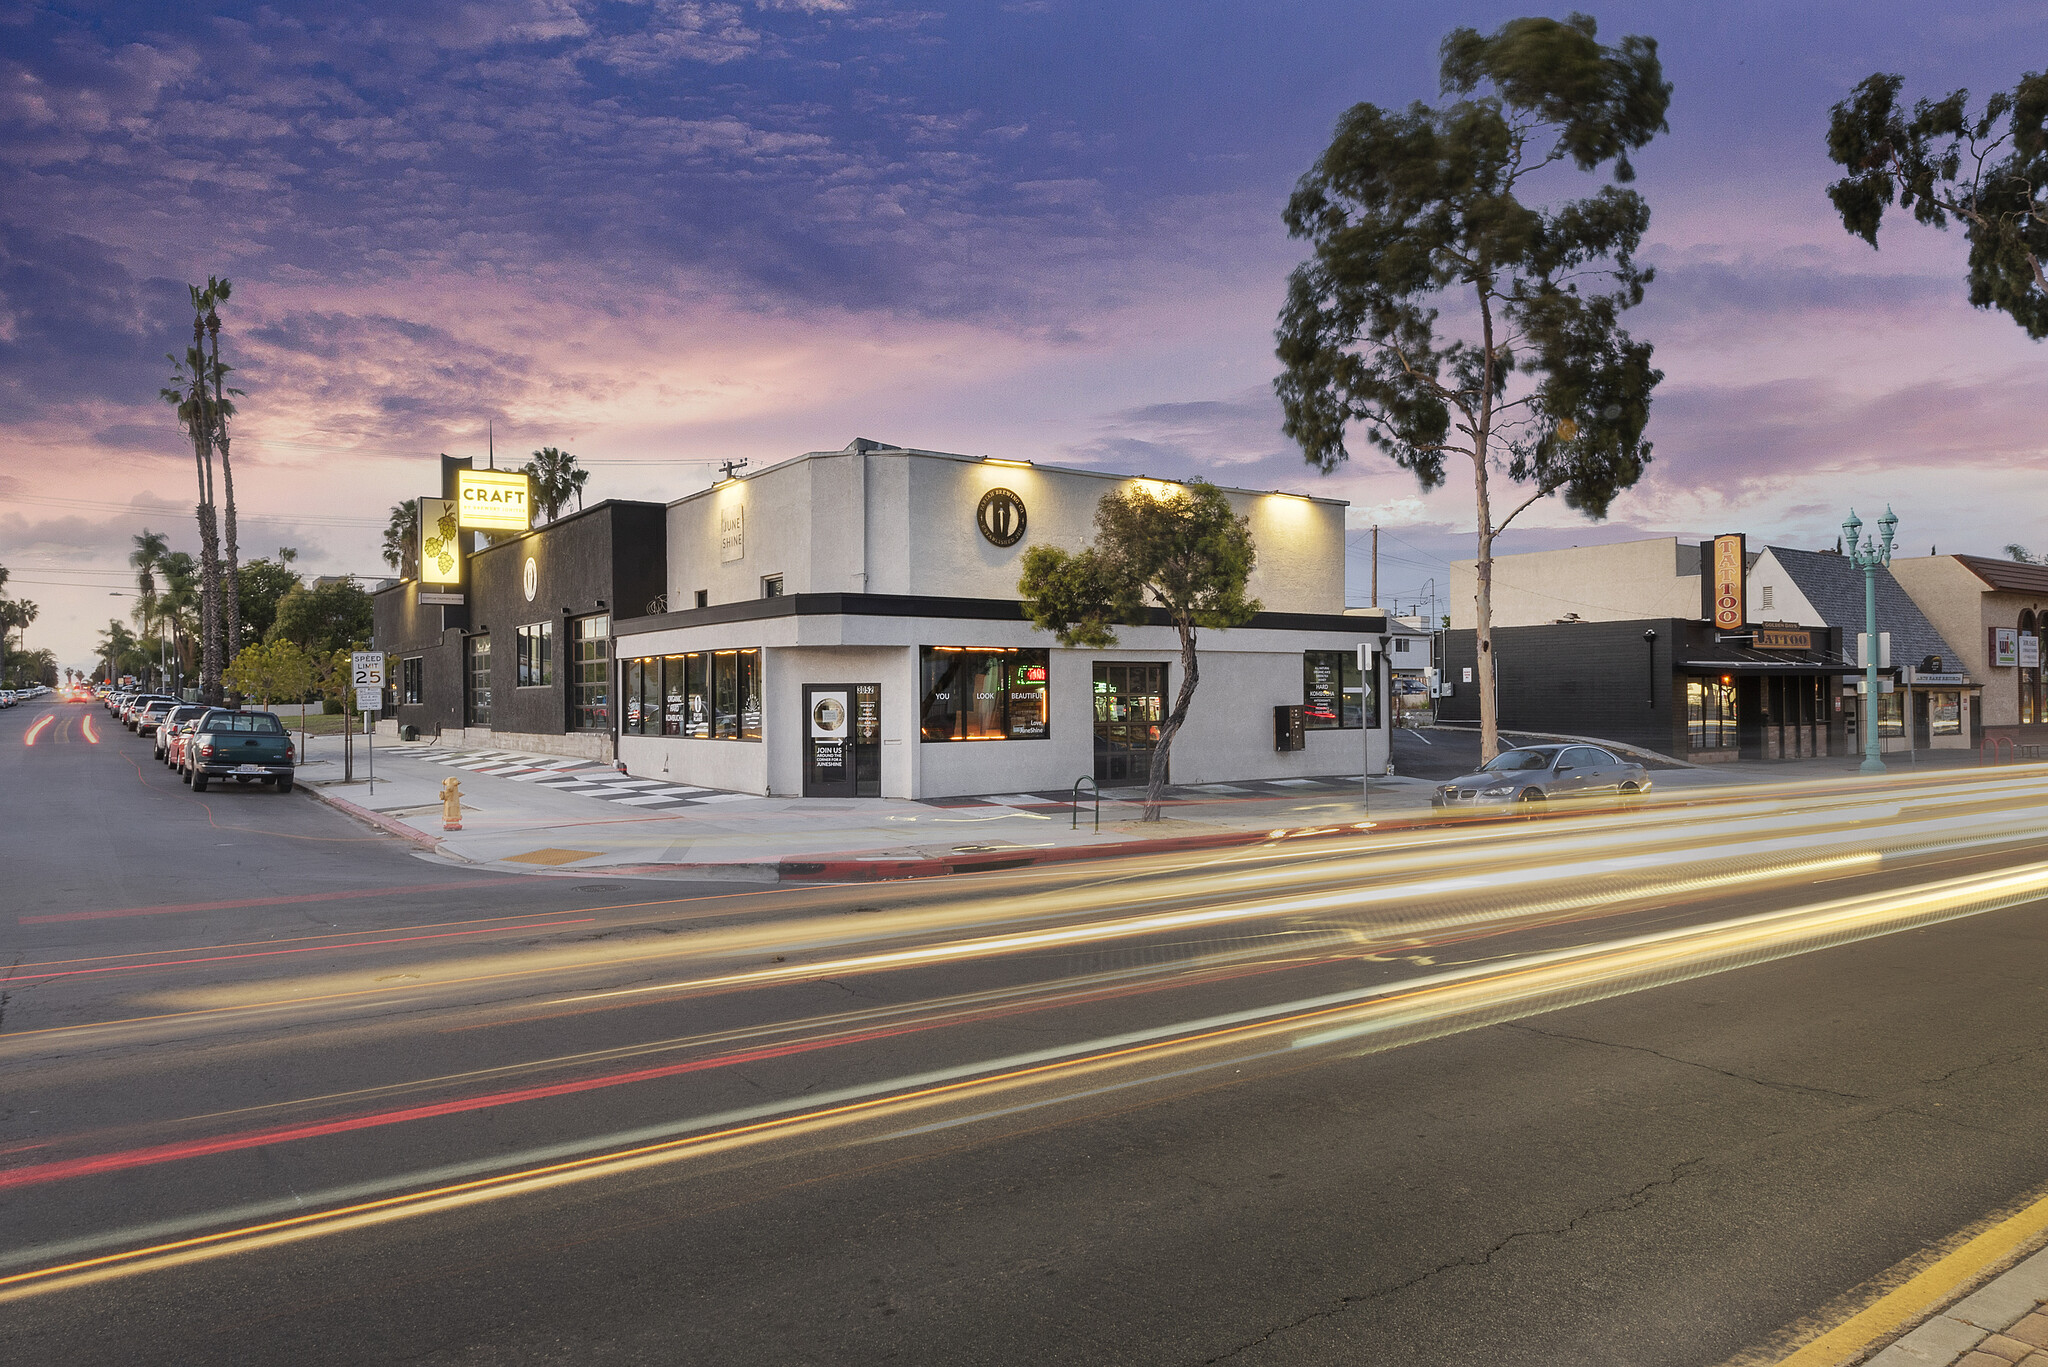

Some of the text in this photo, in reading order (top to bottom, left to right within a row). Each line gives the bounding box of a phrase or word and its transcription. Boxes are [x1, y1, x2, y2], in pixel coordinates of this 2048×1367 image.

[463, 488, 525, 504] CRAFT
[995, 489, 1020, 505] BREWING
[723, 517, 740, 532] JUNE
[722, 533, 742, 549] SHINE
[1717, 540, 1738, 623] TATTOO
[1762, 633, 1808, 647] ATTOO
[355, 671, 381, 684] 25
[856, 685, 875, 694] 3052
[935, 692, 1043, 700] YOU LOOK BEAUTIFUL
